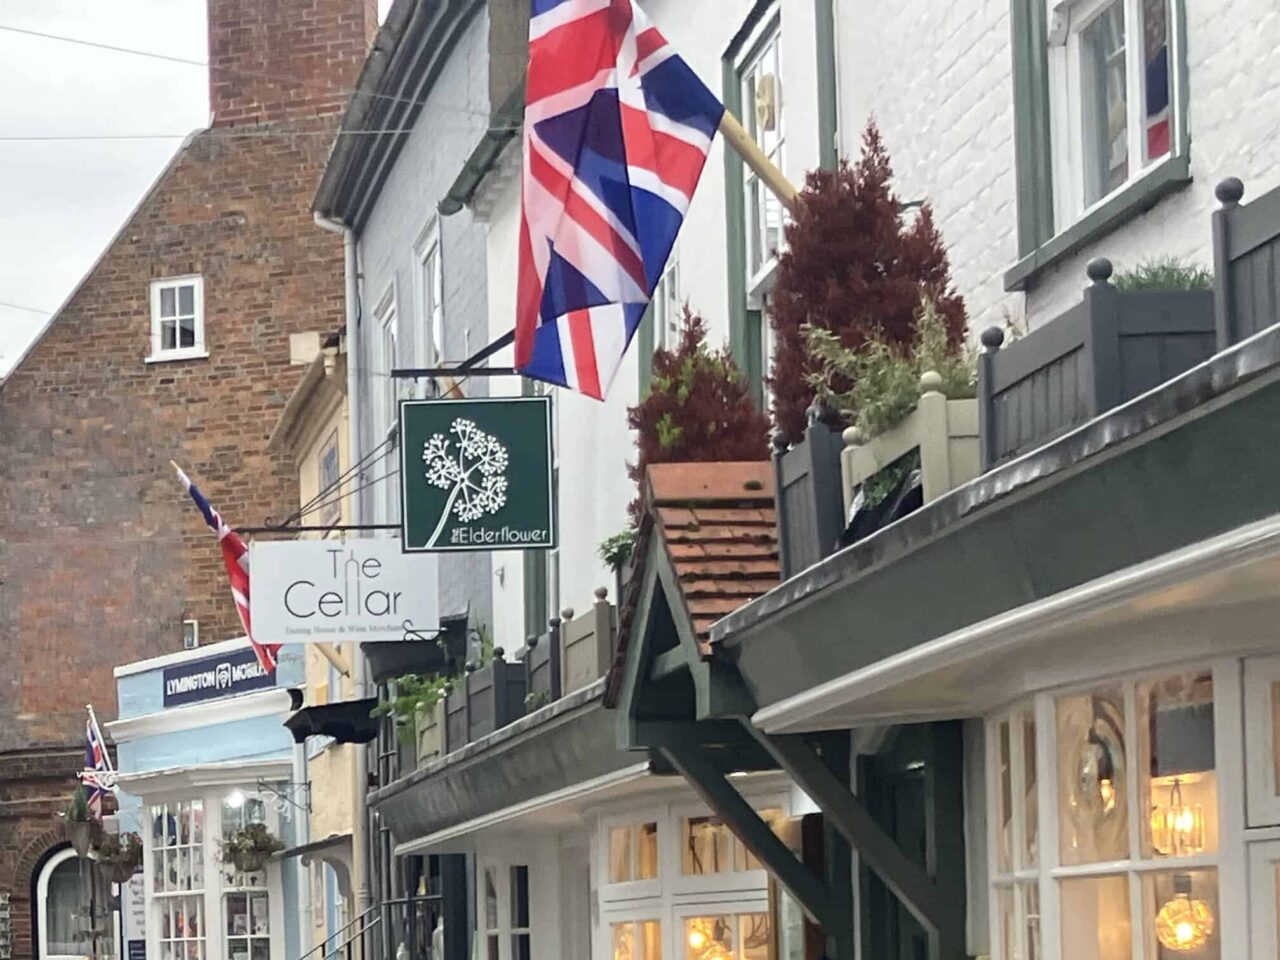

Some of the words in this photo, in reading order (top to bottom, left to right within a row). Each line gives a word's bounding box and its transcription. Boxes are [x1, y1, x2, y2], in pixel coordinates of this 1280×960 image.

[460, 526, 547, 543] Elderflower
[326, 549, 382, 579] The
[284, 579, 402, 618] Cellar
[166, 671, 215, 695] LYMINGTON
[232, 661, 267, 682] MOBIL
